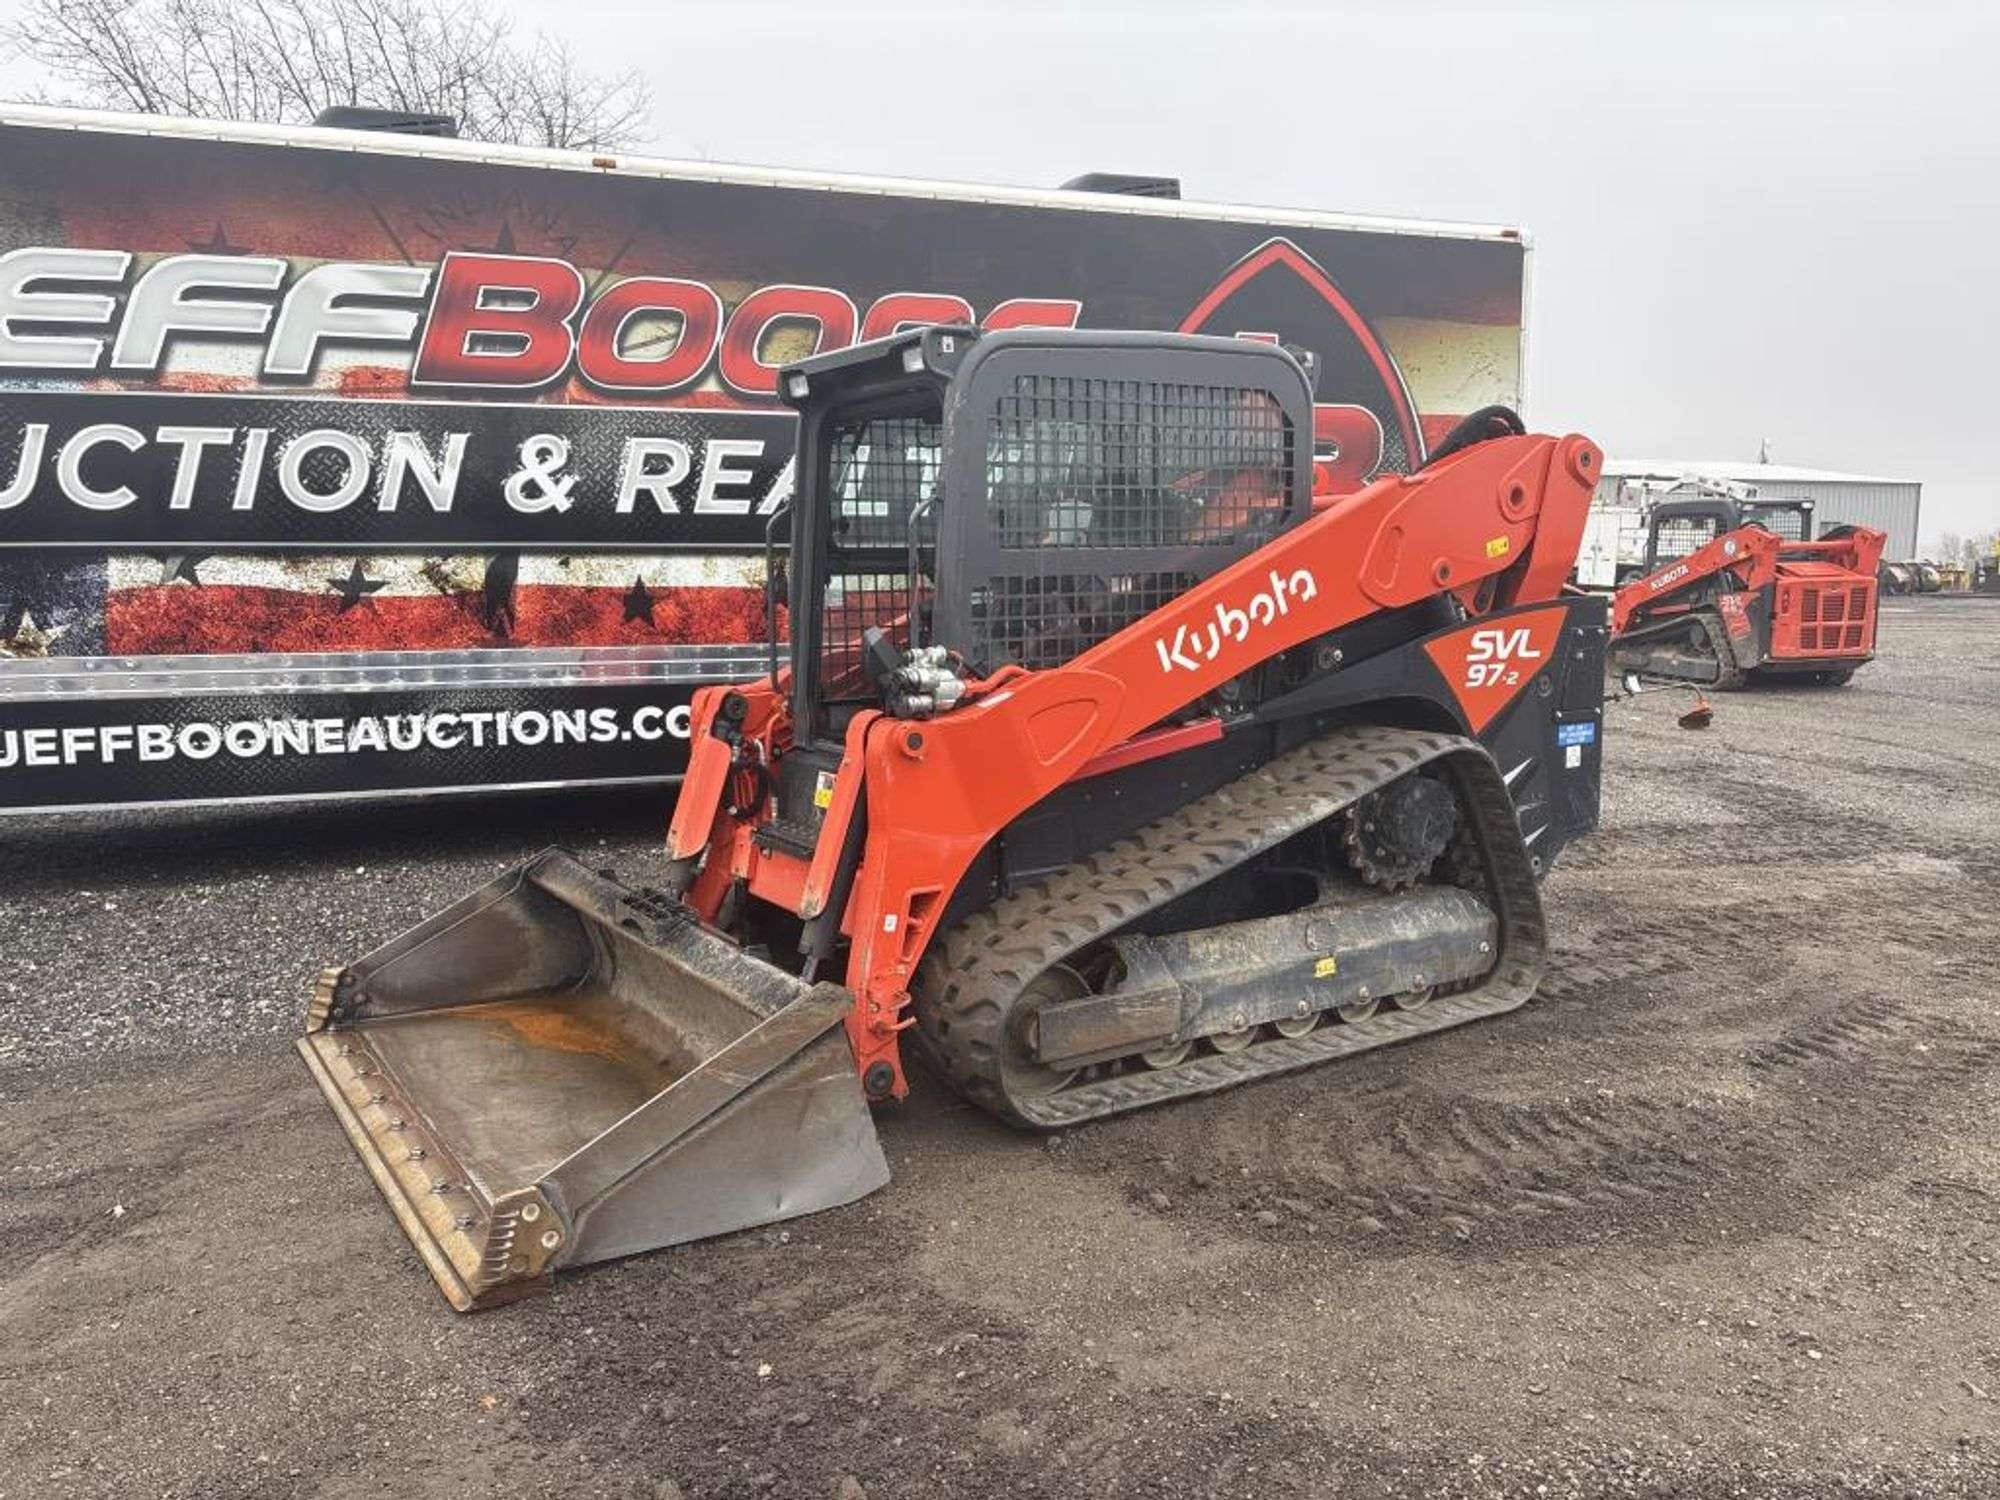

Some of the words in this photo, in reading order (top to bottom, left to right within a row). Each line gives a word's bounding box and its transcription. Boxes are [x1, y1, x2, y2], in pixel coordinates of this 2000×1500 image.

[503, 432, 579, 513] &
[1156, 569, 1318, 673] Kubota
[1466, 628, 1541, 662] SVL
[1464, 662, 1520, 688] 97-2
